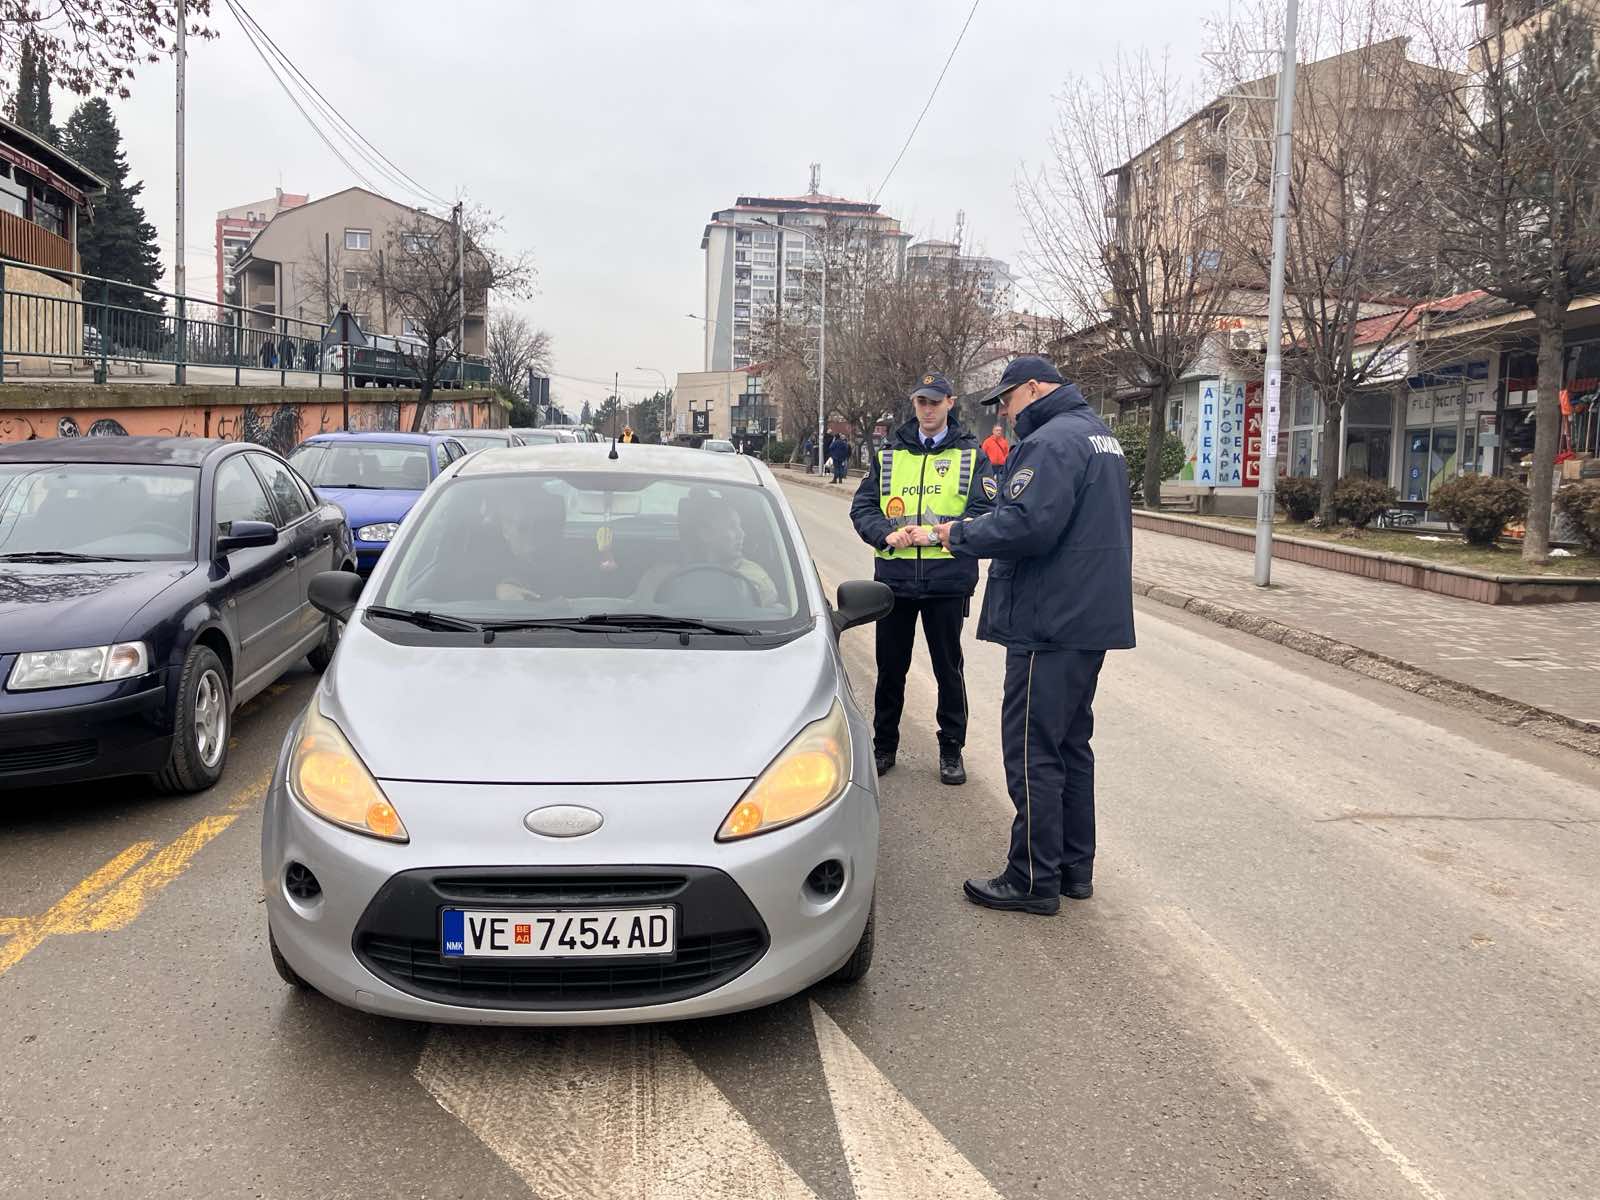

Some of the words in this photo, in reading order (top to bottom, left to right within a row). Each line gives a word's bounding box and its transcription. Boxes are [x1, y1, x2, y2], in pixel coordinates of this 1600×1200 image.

[1201, 387, 1213, 481] АПТЕКА
[1232, 386, 1244, 480] АПТЕКА
[901, 485, 941, 496] POLICE
[446, 941, 464, 951] NMK
[468, 916, 509, 950] VE
[536, 916, 621, 951] 7454
[627, 914, 668, 948] AD
